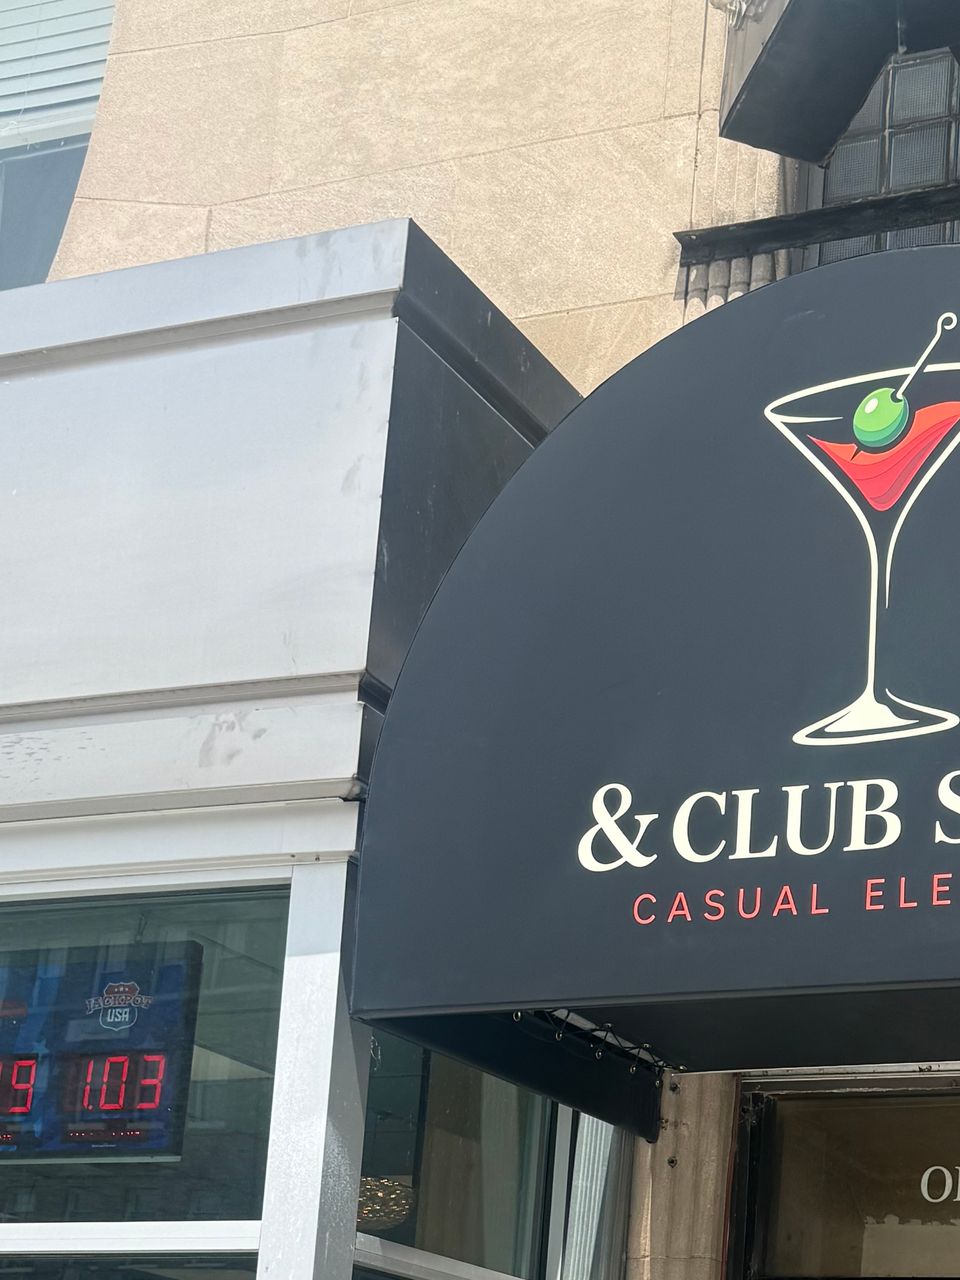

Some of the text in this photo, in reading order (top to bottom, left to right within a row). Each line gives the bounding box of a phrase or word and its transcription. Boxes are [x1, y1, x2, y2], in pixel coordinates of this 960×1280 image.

[577, 783, 659, 872] &
[672, 778, 902, 863] CLUB
[632, 884, 828, 925] CASUAL
[85, 993, 153, 1015] JACKPOT
[107, 1007, 130, 1023] USA
[0, 1059, 37, 1114] 9
